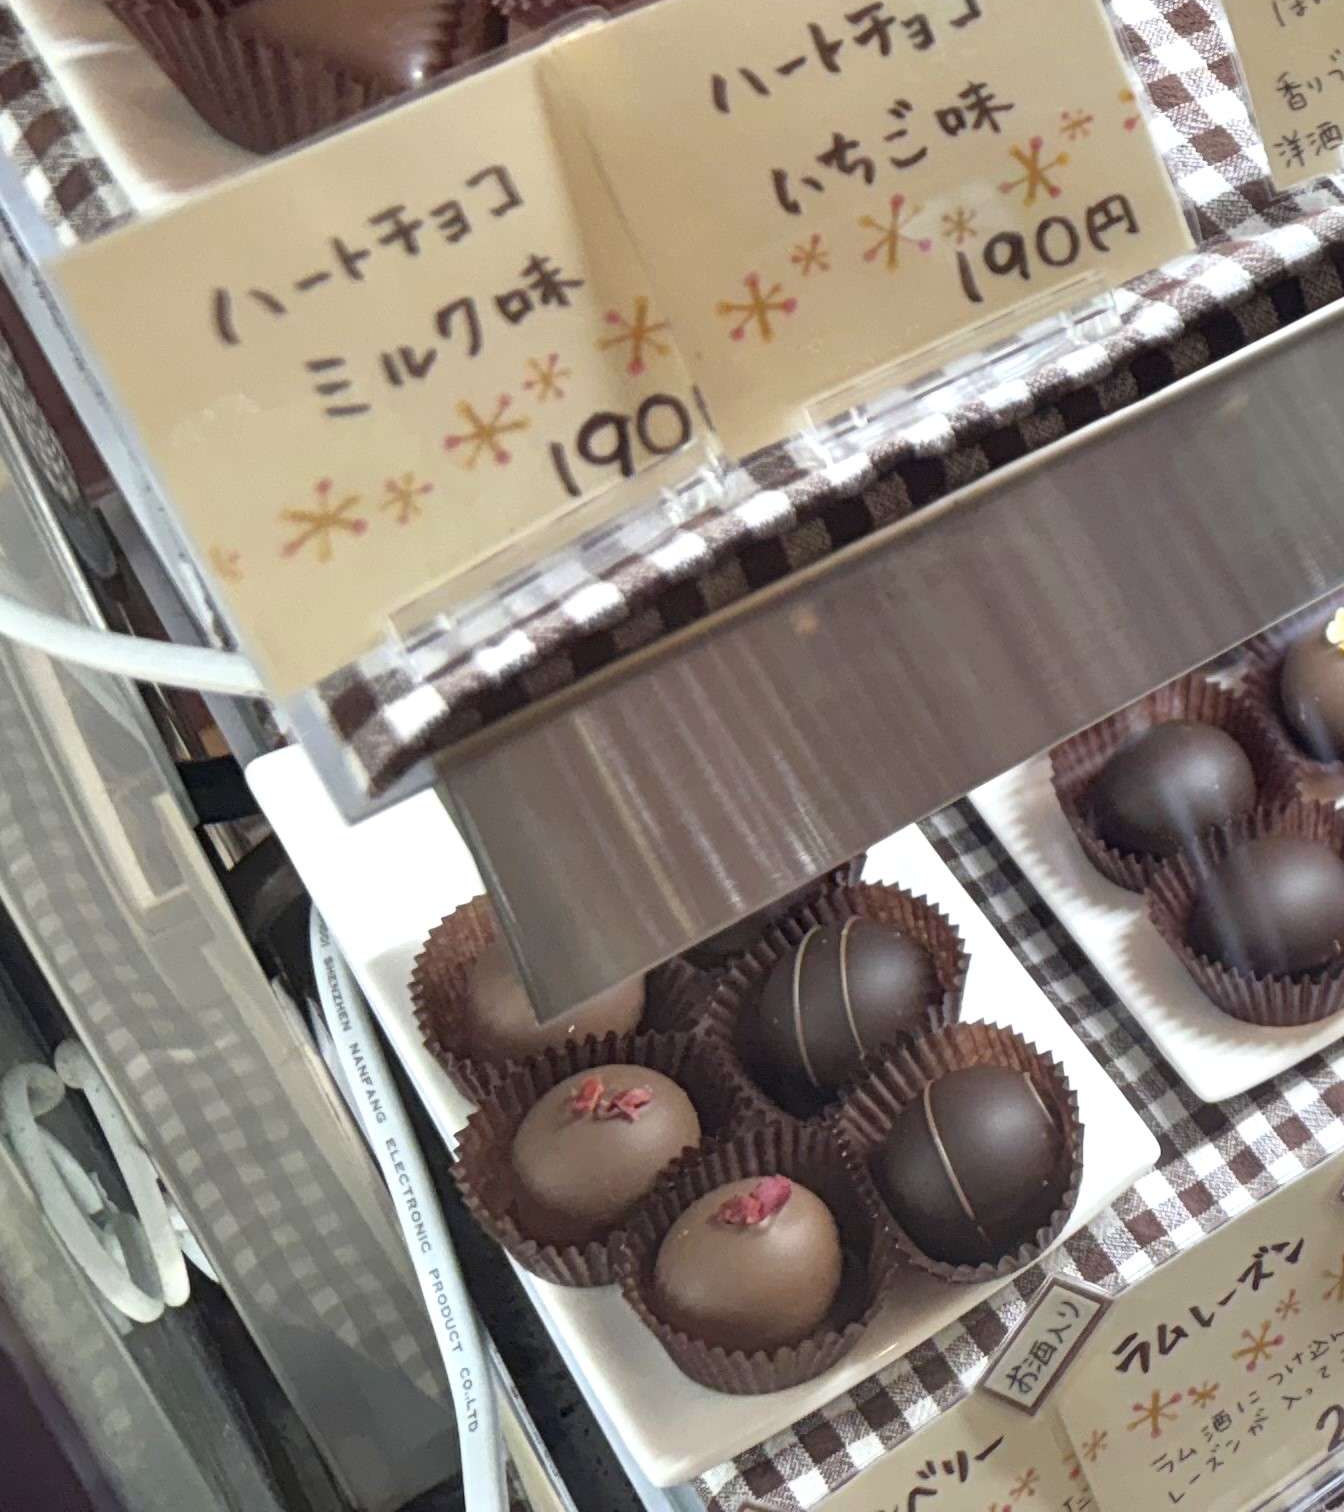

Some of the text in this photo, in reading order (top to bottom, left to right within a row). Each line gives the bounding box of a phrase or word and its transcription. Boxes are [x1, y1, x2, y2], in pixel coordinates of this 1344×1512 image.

[771, 81, 1015, 215] いちご味
[213, 164, 526, 345] ハートチョコ
[956, 192, 1140, 304] 190円
[304, 253, 586, 418] ミルク味
[549, 384, 718, 498] 190
[323, 954, 353, 1033] SHENZHEN
[348, 1041, 389, 1125] NANFANG
[384, 1137, 433, 1256] ELECTRONIC
[427, 1266, 465, 1355] PRODUCT
[1005, 1300, 1083, 1395] お酒入り
[1111, 1237, 1305, 1375] ラムレーズン
